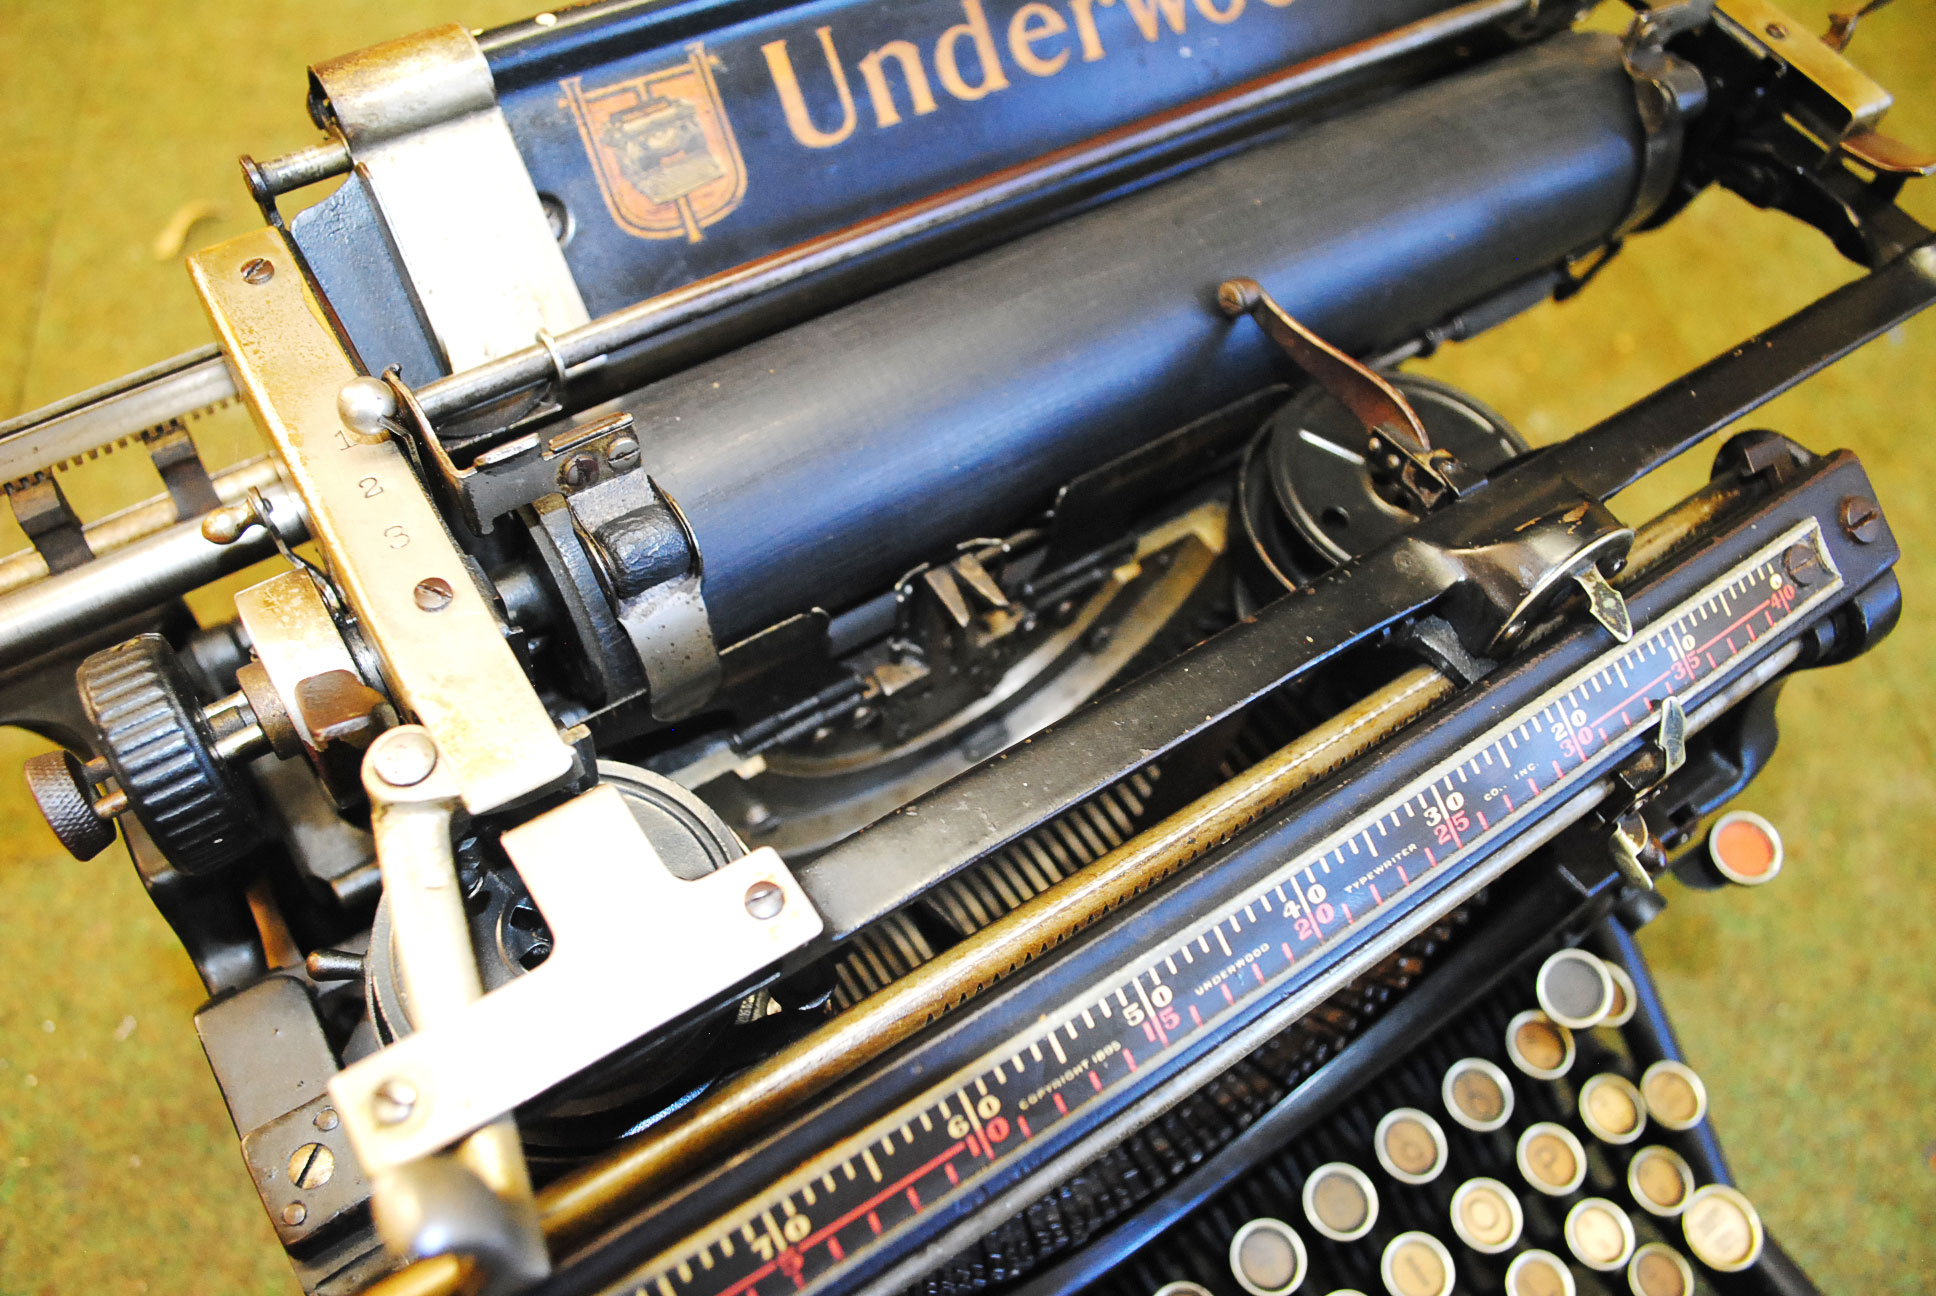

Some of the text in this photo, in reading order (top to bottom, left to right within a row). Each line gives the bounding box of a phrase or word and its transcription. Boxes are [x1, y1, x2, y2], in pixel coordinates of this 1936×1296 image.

[761, 0, 1293, 148] Underw
[334, 430, 358, 451] 1
[358, 477, 384, 499] 2
[384, 525, 411, 549] 3
[947, 1094, 1002, 1139] 60
[1122, 985, 1173, 1027] 50
[1283, 884, 1327, 919] 40
[1423, 792, 1465, 826] 30
[1551, 709, 1587, 741] 20
[1667, 634, 1696, 662] 10
[1769, 573, 1783, 590] 0
[966, 584, 1796, 1157] 10 15 20 25 30 35 40
[1018, 1058, 1089, 1111] COPYRIGHT
[1194, 942, 1270, 996] UNDERWOOD
[1343, 843, 1417, 894] TYPEWRITER
